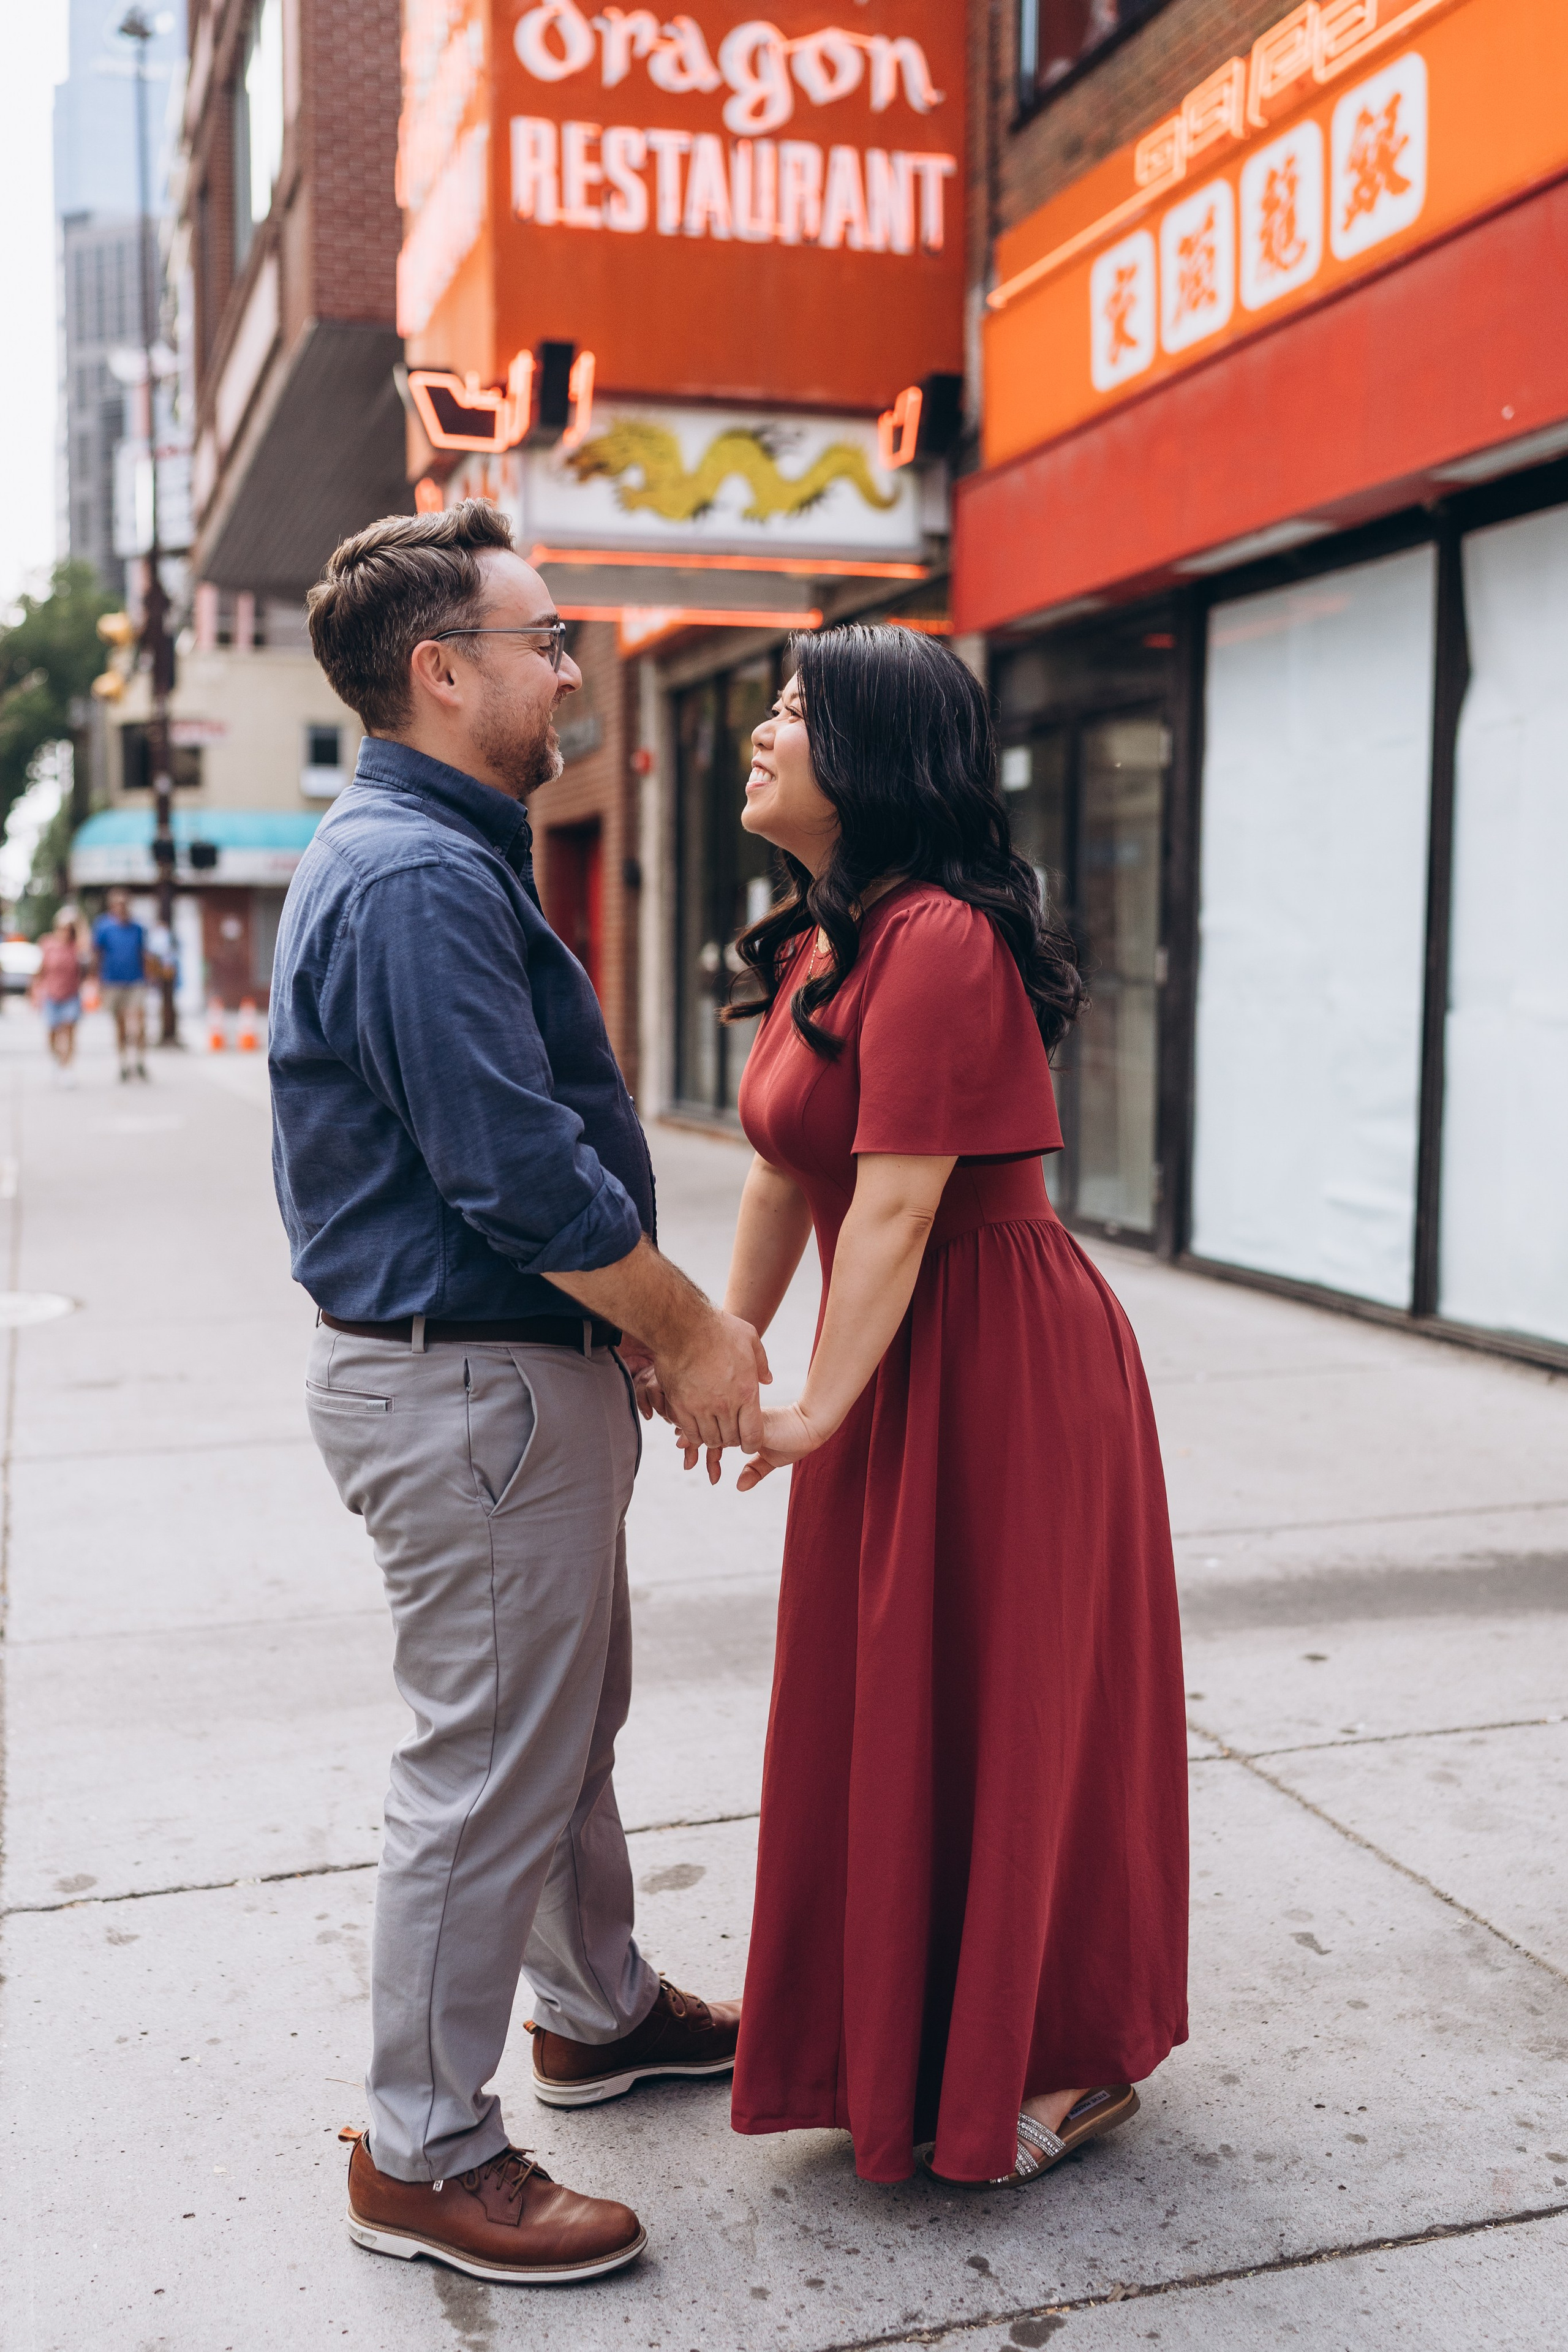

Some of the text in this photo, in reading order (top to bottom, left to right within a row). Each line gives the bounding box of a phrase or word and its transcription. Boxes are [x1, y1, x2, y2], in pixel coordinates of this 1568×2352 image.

[510, 115, 956, 255] RESTAURANT
[1070, 2093, 1107, 2116] STEVE MADDEN
